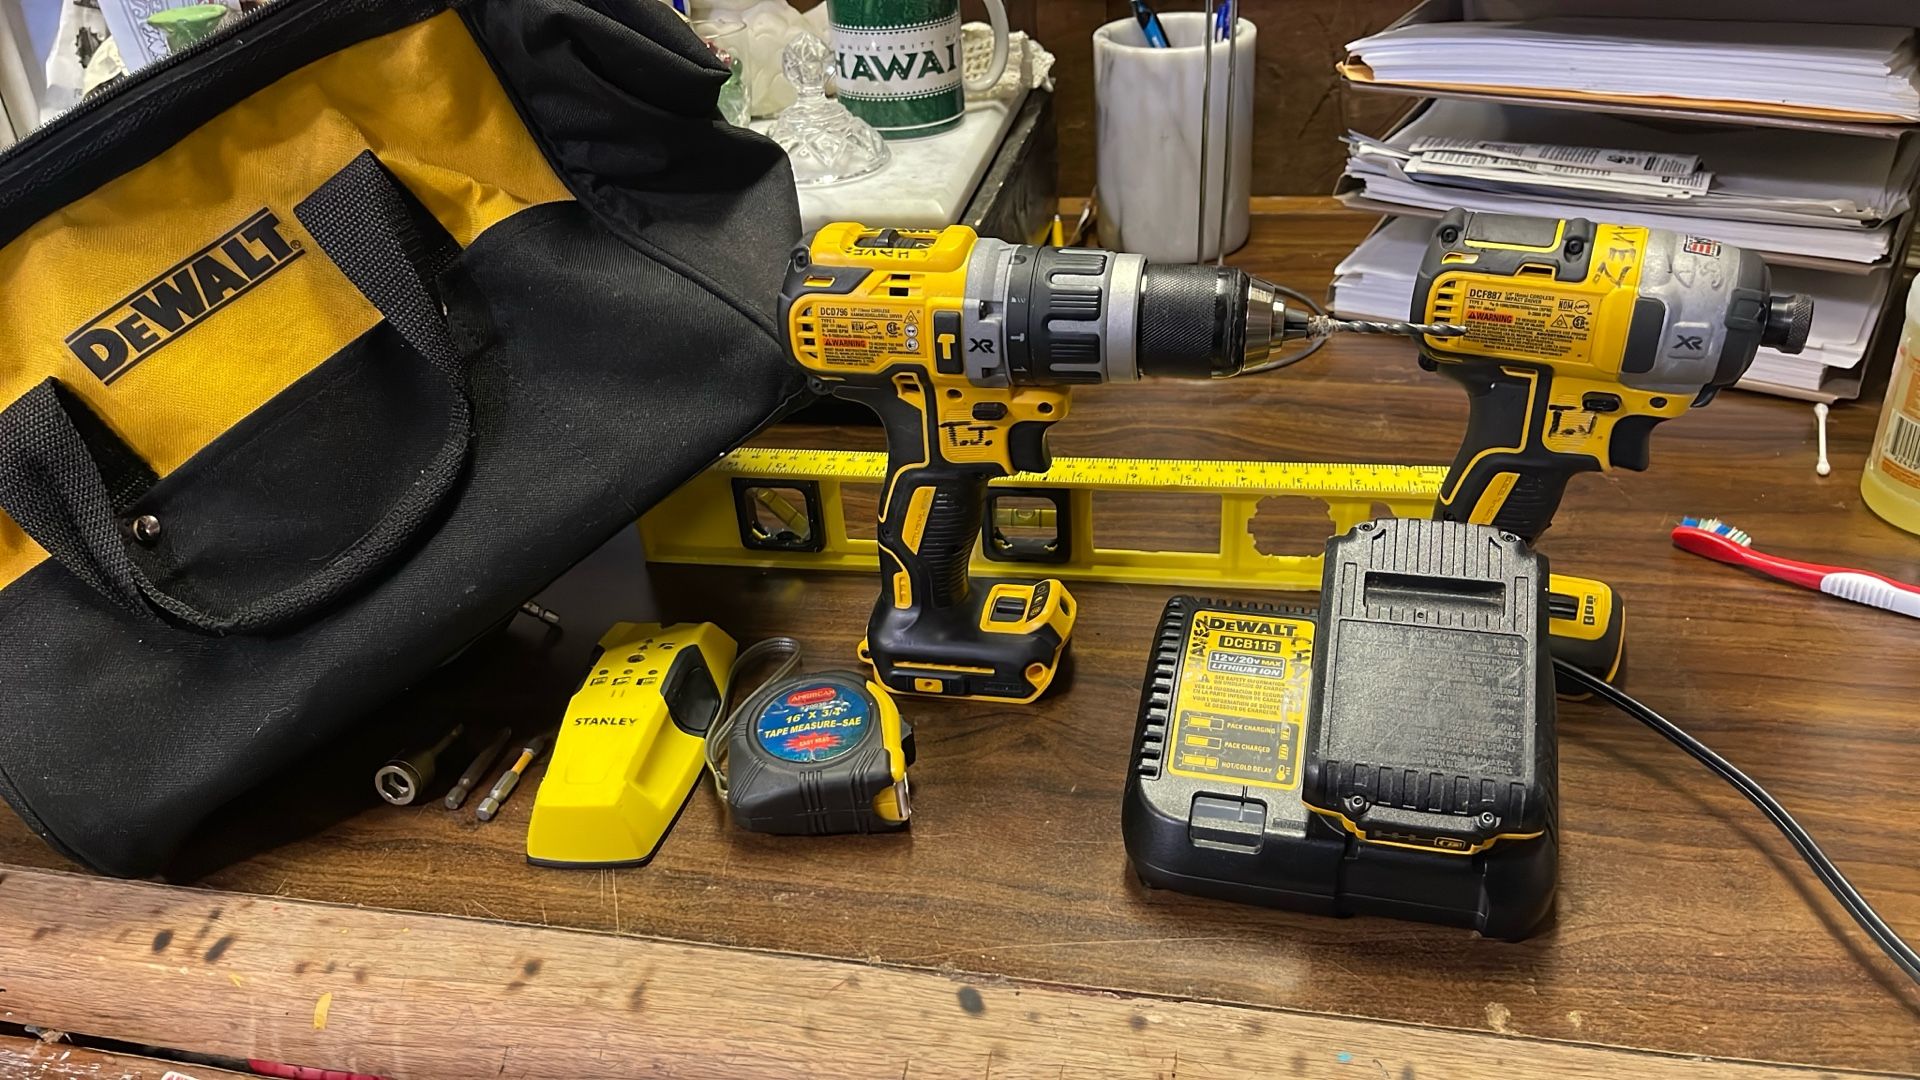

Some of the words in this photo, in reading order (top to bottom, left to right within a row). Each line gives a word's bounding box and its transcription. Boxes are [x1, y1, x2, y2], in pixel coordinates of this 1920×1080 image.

[1478, 312, 1512, 324] WARNING
[832, 339, 866, 348] WARNING
[969, 337, 996, 354] XR
[1673, 334, 1703, 351] XR
[1223, 637, 1276, 652] DCB115
[1261, 659, 1281, 667] MAX
[1211, 663, 1256, 674] LITHIUM
[1259, 668, 1281, 677] ION
[791, 689, 836, 702] AMERICAN
[808, 710, 816, 720] X
[574, 717, 638, 727] STANLEY
[1226, 722, 1243, 730] PACK
[1244, 726, 1276, 734] CHARGING
[764, 727, 789, 738] TAPE
[1224, 741, 1240, 749] PACK
[1241, 744, 1271, 753] CHARGED
[1222, 762, 1252, 771] HOT/COLD
[1252, 766, 1272, 774] DELAY
